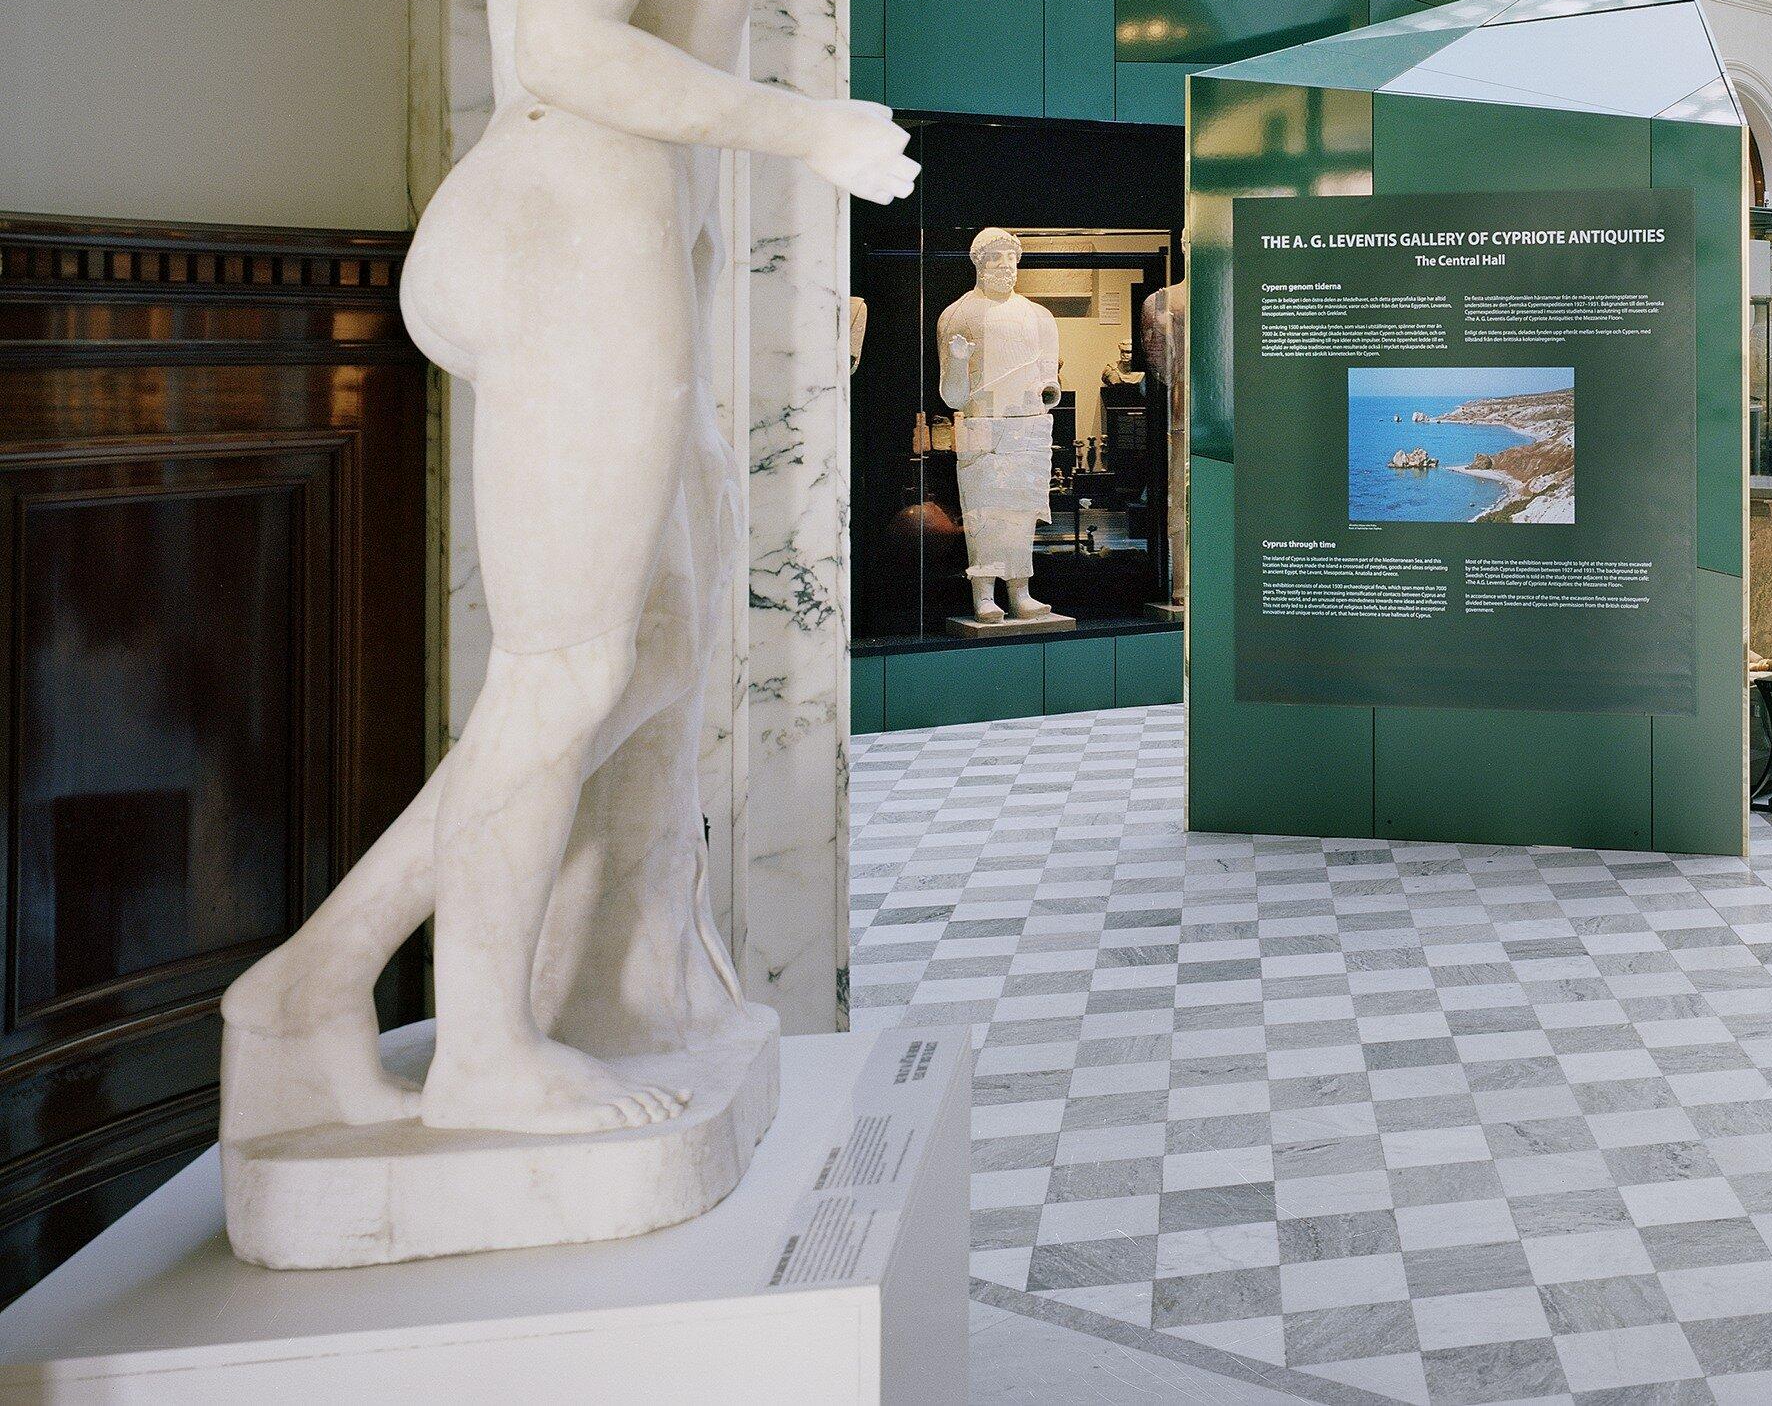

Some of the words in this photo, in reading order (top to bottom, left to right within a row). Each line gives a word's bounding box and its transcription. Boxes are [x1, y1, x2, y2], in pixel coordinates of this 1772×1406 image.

[1260, 235, 1289, 248] THE
[1291, 235, 1307, 248] A.
[1308, 234, 1326, 248] G.
[1327, 233, 1398, 248] LEVENTIS
[1400, 232, 1466, 246] GALLERY
[1468, 232, 1490, 246] OF
[1491, 231, 1565, 245] CYPRIOTE
[1566, 229, 1666, 247] ANTIQUITIES
[1414, 254, 1436, 265] The
[1437, 254, 1480, 265] Central
[1481, 253, 1506, 265] Hall
[1261, 283, 1288, 292] Cypern
[1287, 284, 1314, 292] genom
[1313, 282, 1342, 290] tiderna
[1262, 540, 1288, 549] Cyprus
[1288, 540, 1319, 549] through
[1318, 540, 1336, 548] time
